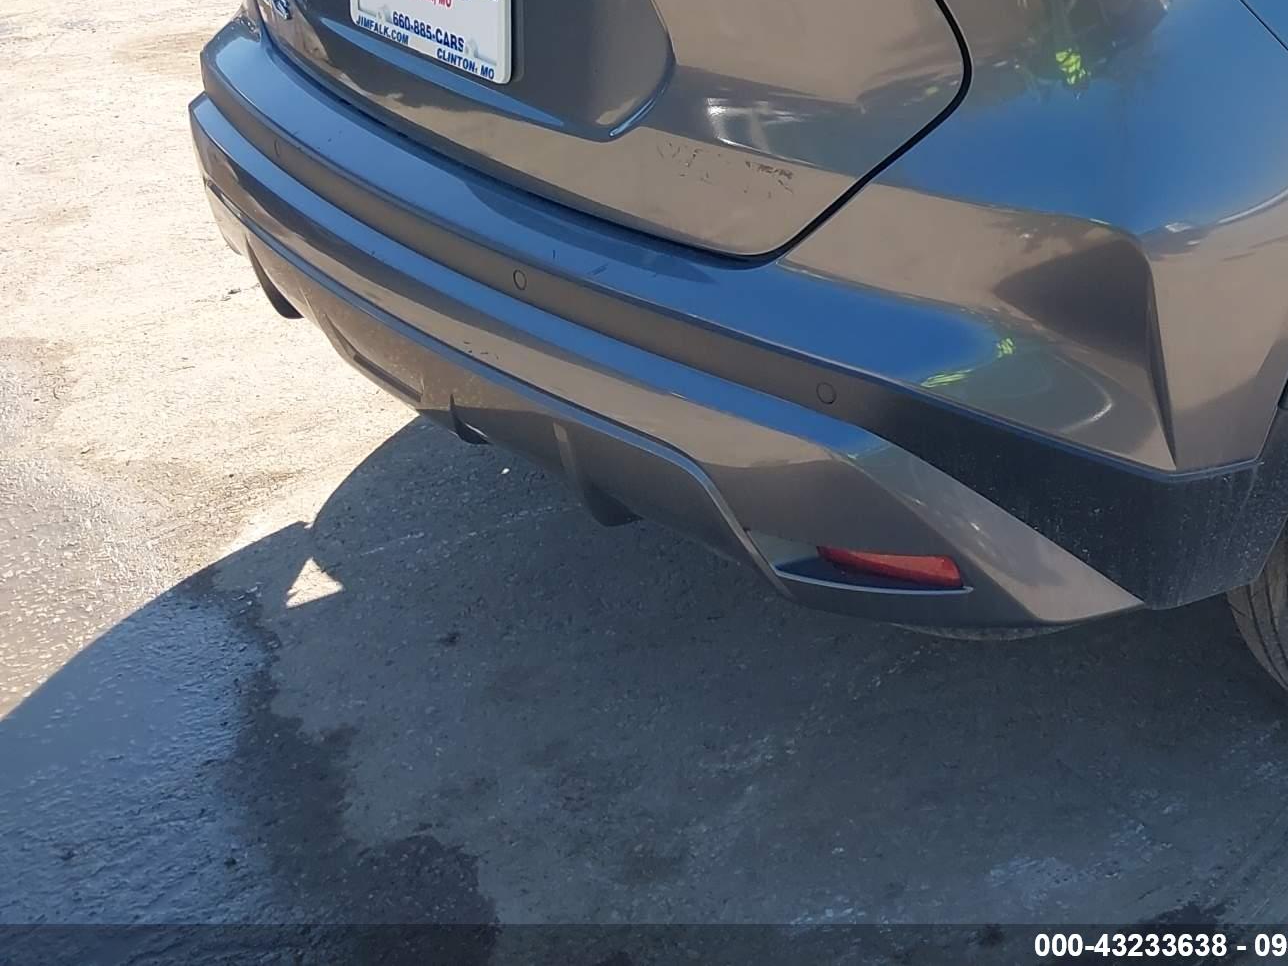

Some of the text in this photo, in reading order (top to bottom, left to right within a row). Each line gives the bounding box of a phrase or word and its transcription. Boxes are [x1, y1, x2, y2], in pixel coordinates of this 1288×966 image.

[356, 15, 409, 45] JIMFALK.COM
[392, 11, 465, 52] 660-885-CARS
[480, 64, 495, 80] MO
